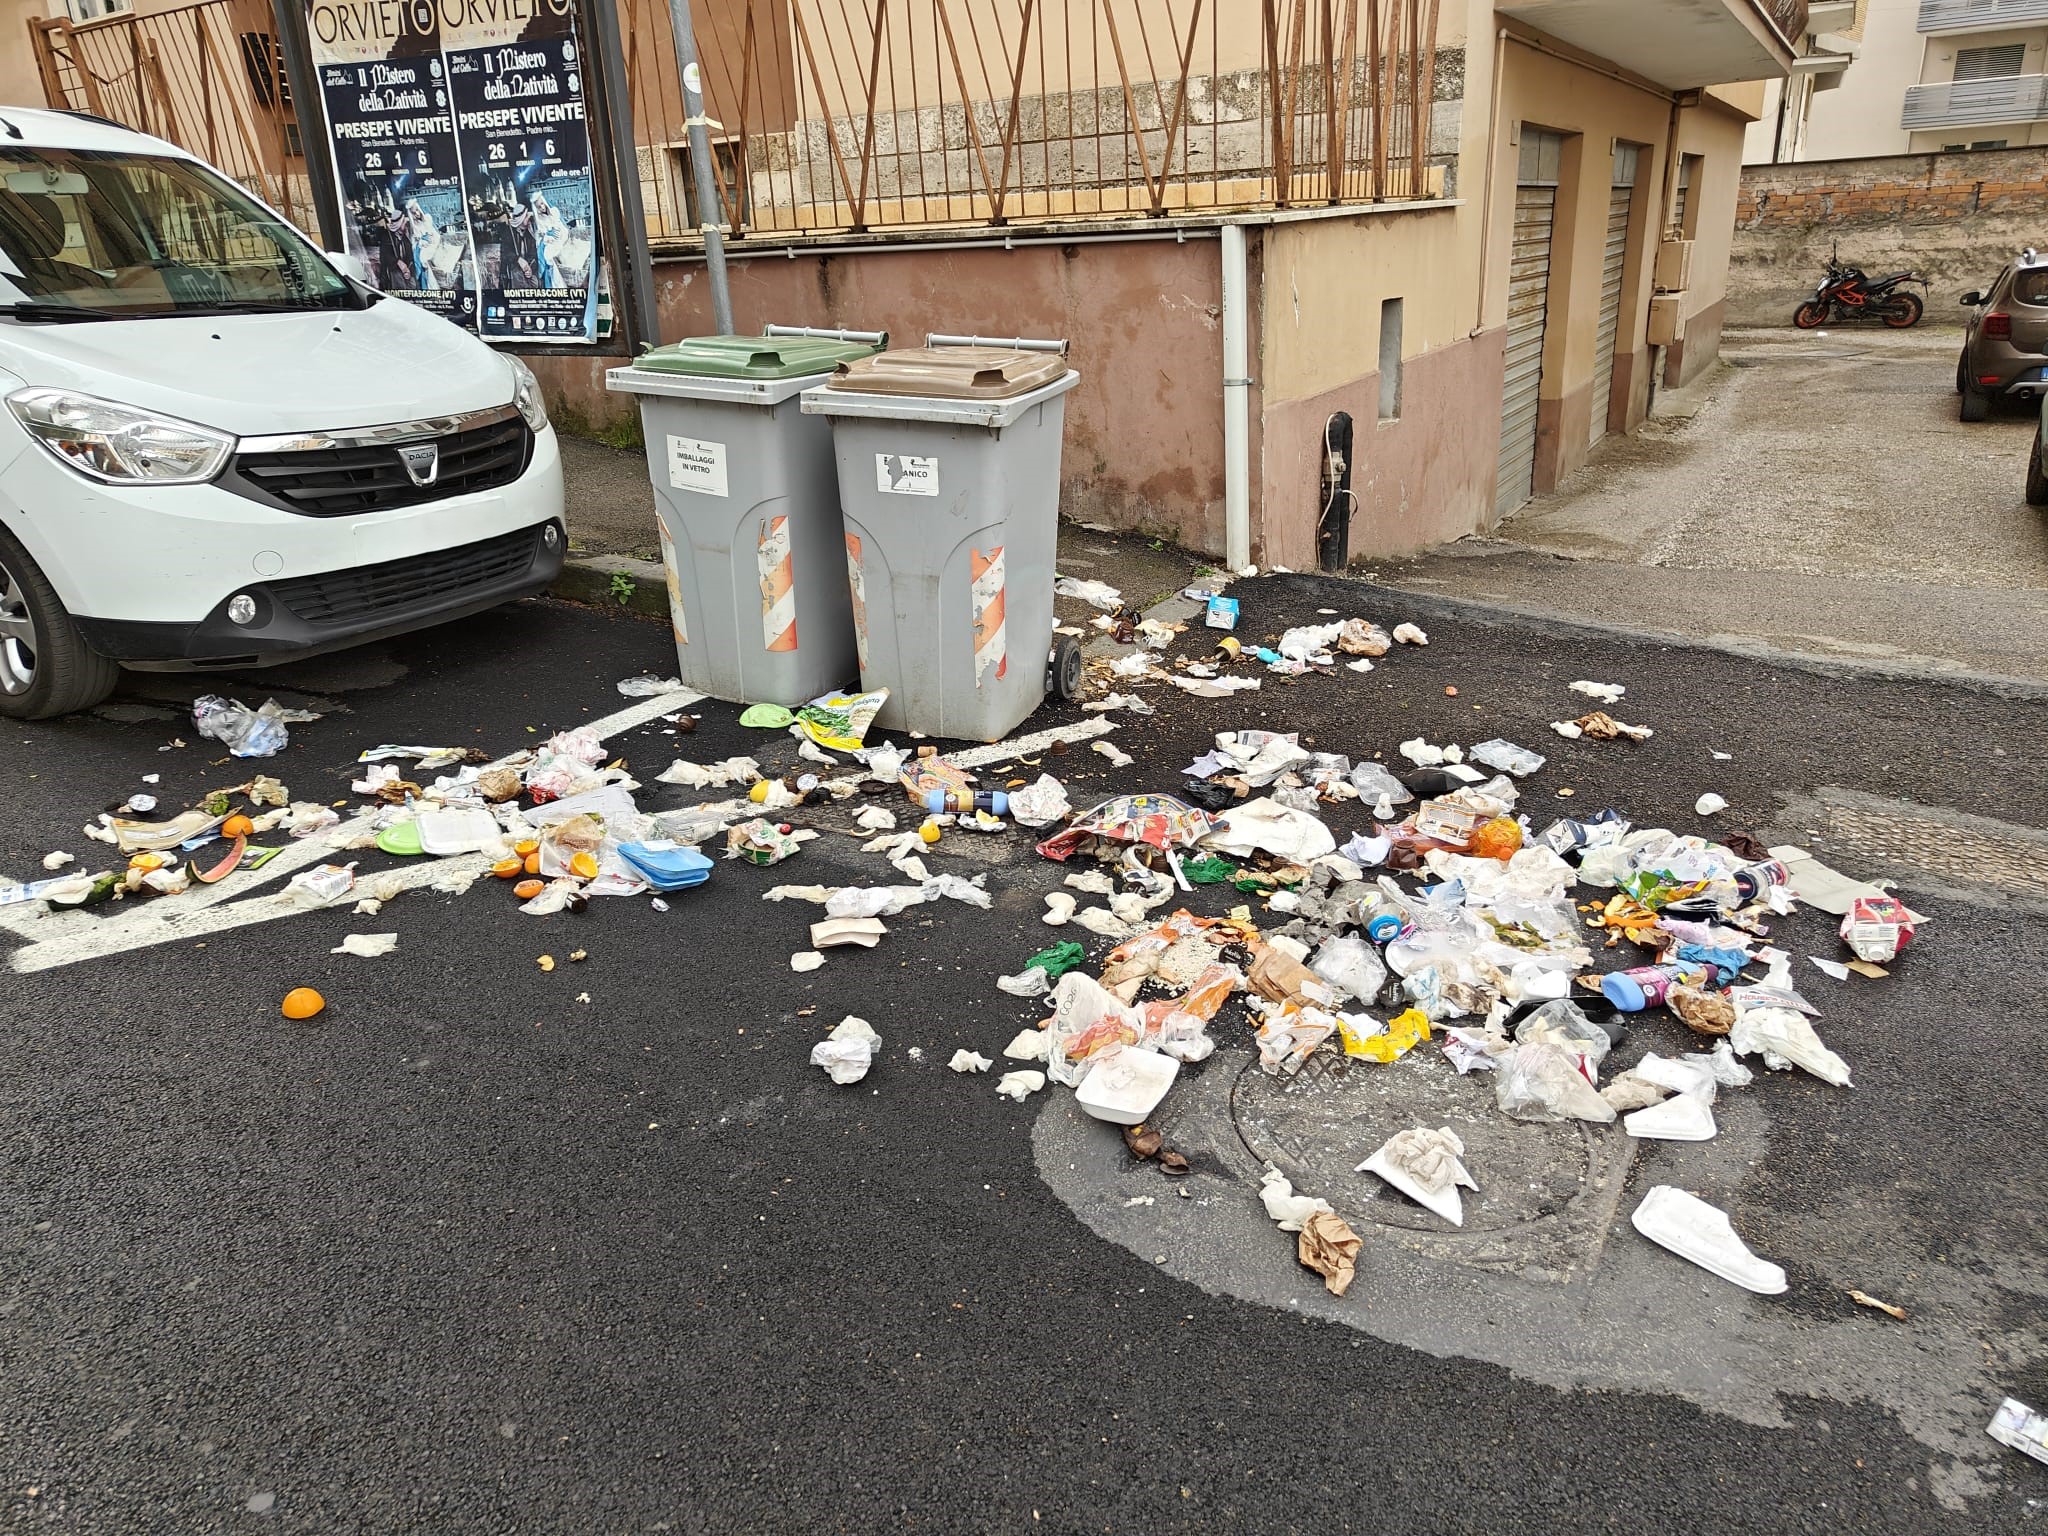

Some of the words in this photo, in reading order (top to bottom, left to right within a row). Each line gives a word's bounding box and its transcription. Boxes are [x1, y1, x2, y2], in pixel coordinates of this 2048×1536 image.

[314, 0, 435, 44] ORVIETO
[496, 48, 547, 79] Mistero
[369, 64, 416, 92] Mistero
[484, 79, 511, 100] della
[510, 73, 559, 97] Natività
[358, 93, 385, 112] della
[384, 89, 428, 110] Natività
[460, 108, 520, 130] PRESEPE
[521, 102, 585, 124] VIVENTE
[335, 120, 394, 139] PRESEPE
[394, 116, 452, 135] VIVENTE
[365, 152, 382, 168] 26
[395, 151, 402, 166] 1
[417, 150, 427, 165] 6
[488, 142, 506, 160] 26
[519, 141, 528, 158] 1
[545, 139, 555, 156] 6
[450, 176, 458, 184] 17
[442, 290, 456, 300] (VT)
[504, 289, 569, 298] MONTEFIASCONE
[570, 289, 586, 300] (VT)
[408, 451, 435, 461] DACIA
[677, 452, 715, 464] IMBALLAGGI
[689, 464, 711, 474] VETRO
